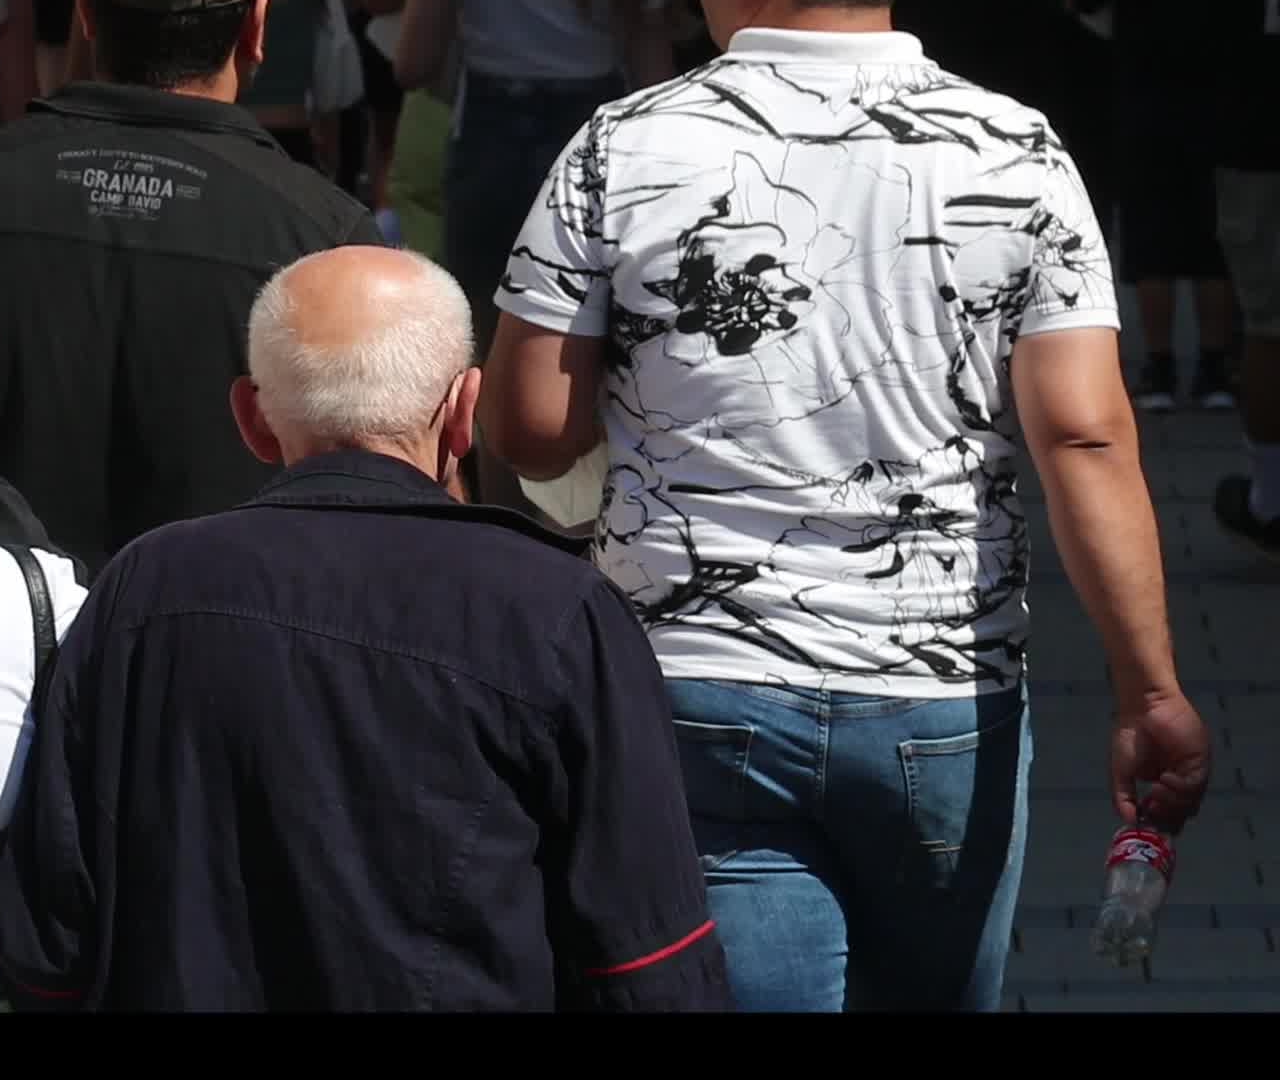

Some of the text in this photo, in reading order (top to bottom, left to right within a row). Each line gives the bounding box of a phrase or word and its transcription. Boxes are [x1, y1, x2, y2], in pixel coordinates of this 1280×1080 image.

[82, 168, 174, 199] GRANADA
[90, 188, 163, 211] CAMP DAVID
